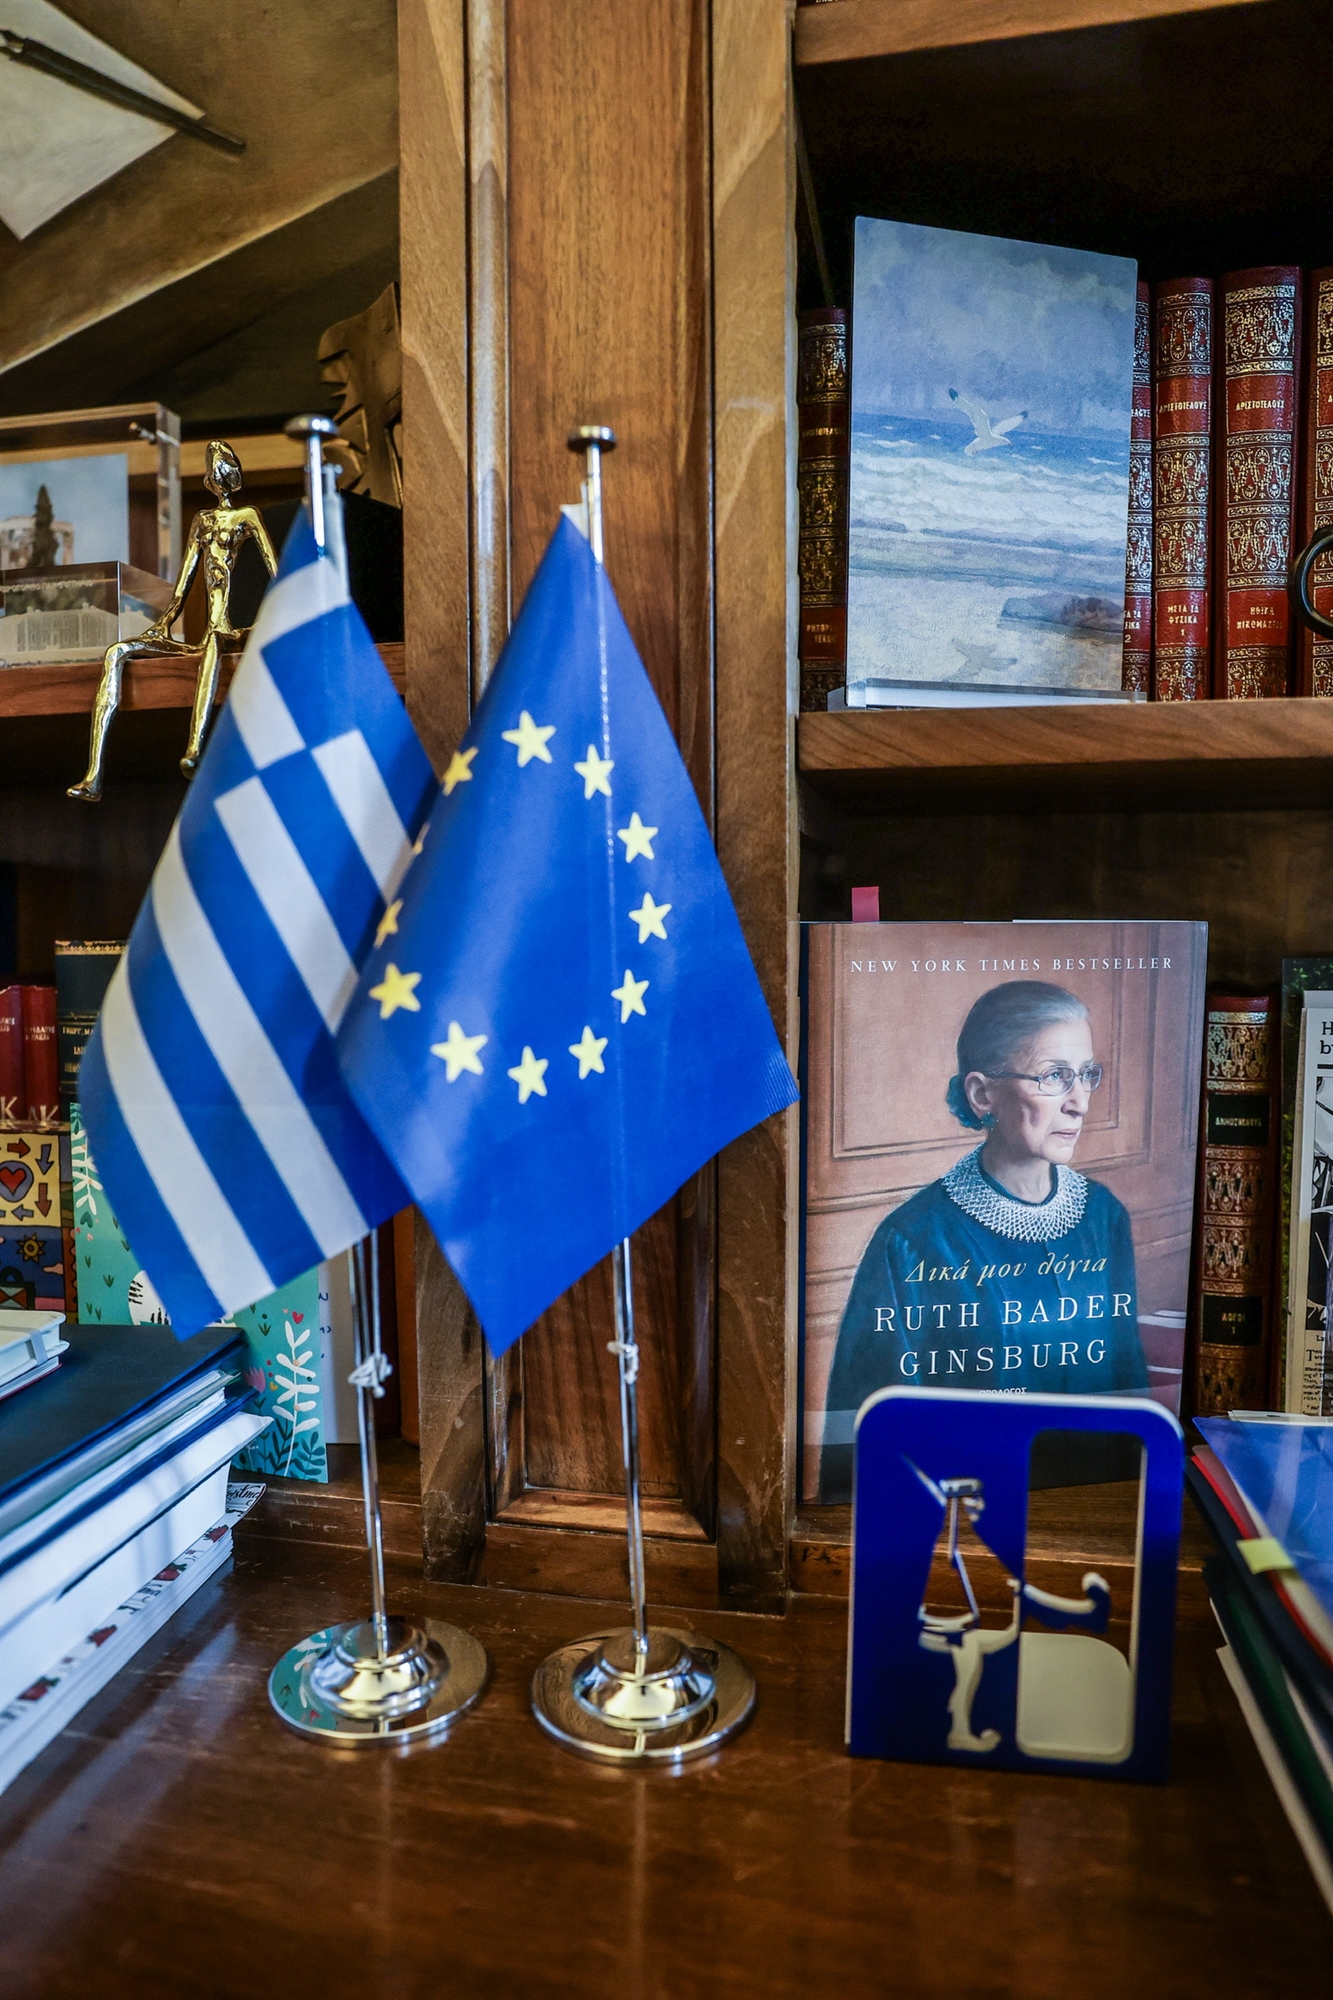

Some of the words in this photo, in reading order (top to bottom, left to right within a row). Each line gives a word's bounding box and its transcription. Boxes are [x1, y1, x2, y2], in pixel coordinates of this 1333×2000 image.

[1160, 401, 1208, 413] ΑΡΙΣΤΟΤΕΛΟΥΣ
[1236, 399, 1285, 411] ΑΡΙΣΤΟΤΕΛΟΥΣ
[1167, 604, 1187, 613] ΜΕΤΑ
[1168, 615, 1198, 624] ΦΥΣΙΚΑ
[1124, 634, 1132, 643] 2
[850, 960, 898, 972] NEW
[911, 959, 967, 972] YORK
[979, 958, 1041, 971] TIMES
[1052, 957, 1173, 971] BESTSELLER
[905, 1258, 971, 1283] Δικά
[976, 1261, 1027, 1287] μου
[1037, 1252, 1108, 1282] λόγια
[874, 1303, 980, 1333] RUTH
[1002, 1293, 1132, 1325] BADER
[900, 1339, 1106, 1377] GINSBURG
